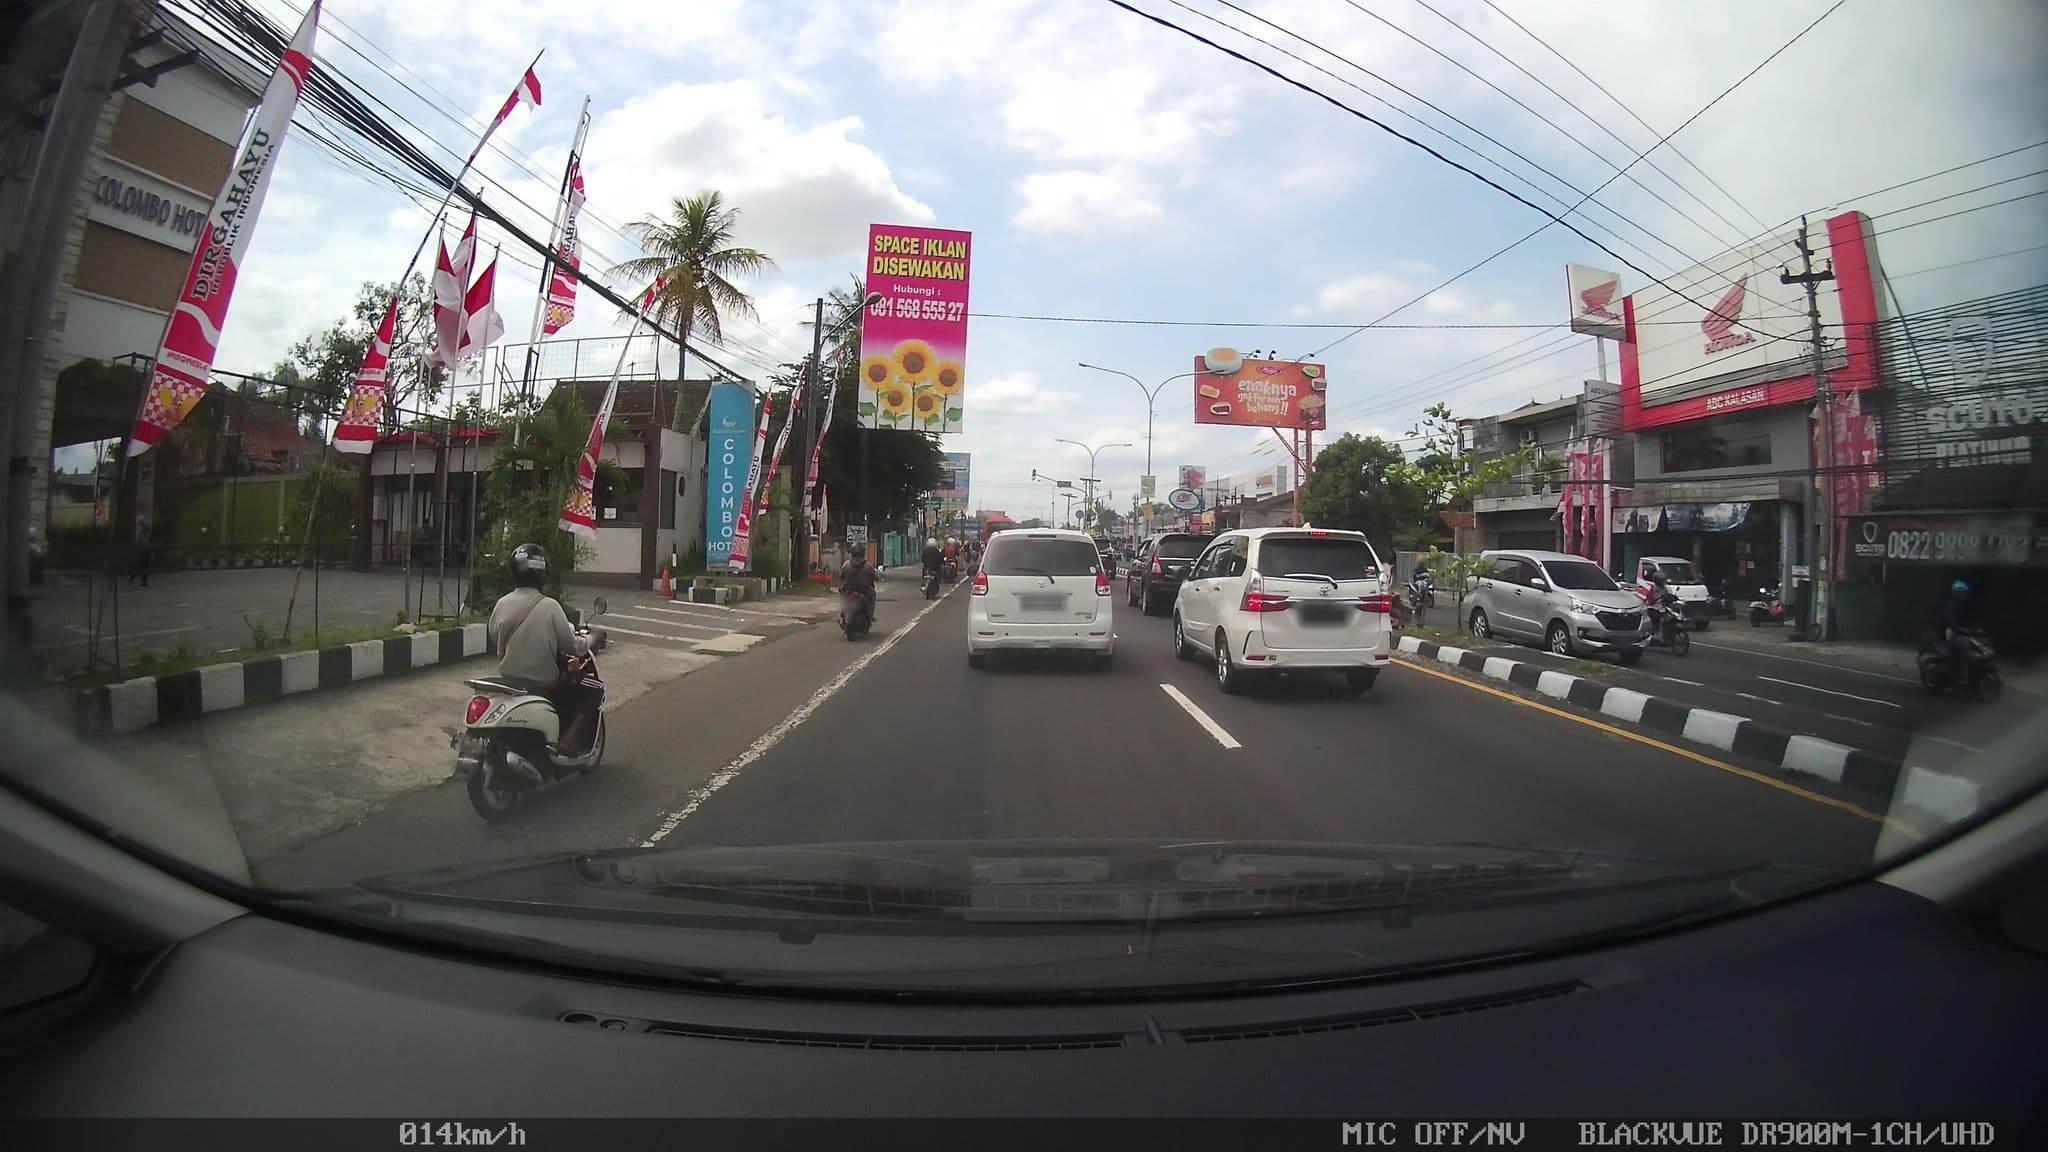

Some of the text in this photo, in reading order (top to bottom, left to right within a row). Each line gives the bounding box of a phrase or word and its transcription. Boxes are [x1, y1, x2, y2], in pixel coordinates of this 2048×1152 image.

[95, 174, 208, 239] COLOMBO HOT
[192, 127, 271, 300] DIRGAHAYU
[211, 144, 275, 294] REPUBLIK INDONESIA
[874, 234, 967, 259] SPACE IKLAN
[872, 256, 965, 281] DISEWAKAN
[893, 284, 935, 296] Hubungi
[895, 298, 920, 319] 568
[921, 299, 946, 321] 555
[946, 302, 965, 322] 27
[166, 351, 208, 372] INDONESIA
[1238, 379, 1297, 400] enaknya
[1706, 388, 1765, 411] ABC KALASAN
[1926, 399, 2034, 433] SCUTO
[721, 438, 736, 538] COLOMBO
[708, 542, 732, 551] HOT
[1887, 530, 1930, 560] 0822
